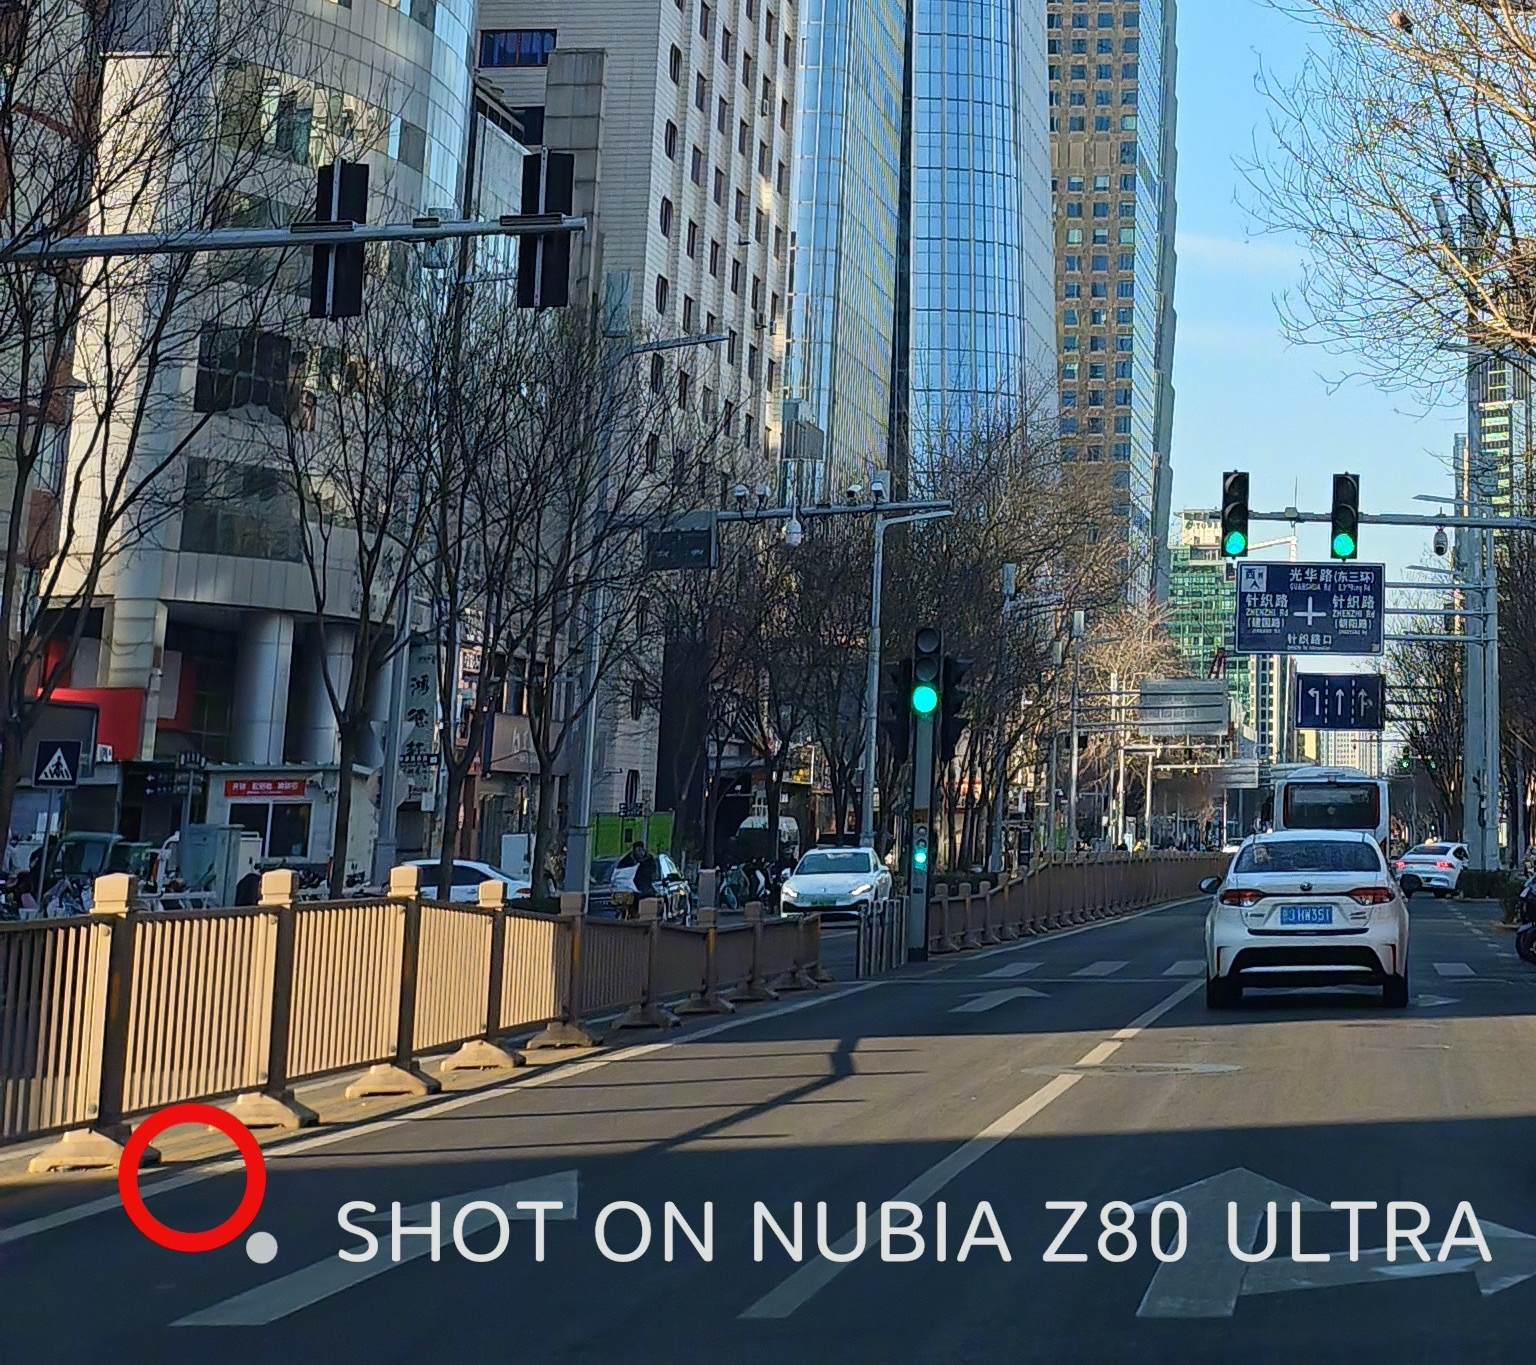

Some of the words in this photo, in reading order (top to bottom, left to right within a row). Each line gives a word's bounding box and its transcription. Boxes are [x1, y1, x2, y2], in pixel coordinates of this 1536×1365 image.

[1289, 567, 1375, 584] 光华路(东三环)
[1245, 593, 1288, 608] 针织路
[1332, 594, 1375, 609] 针织路
[1287, 633, 1332, 645] 针织路口
